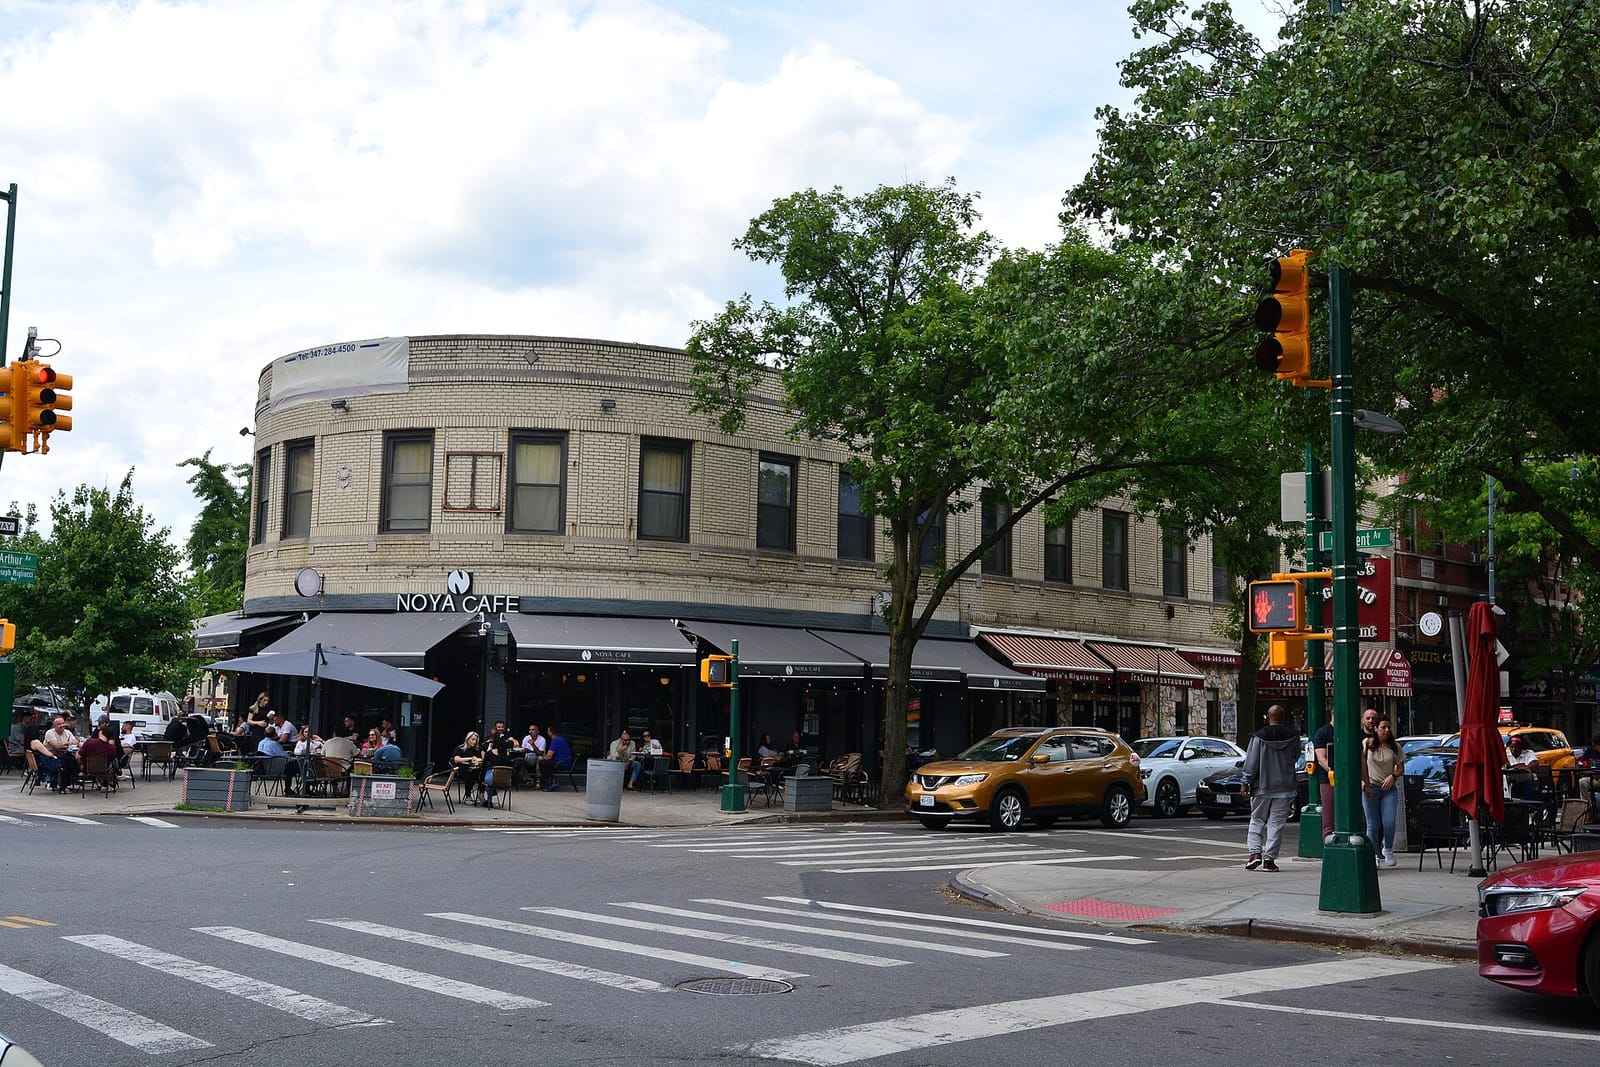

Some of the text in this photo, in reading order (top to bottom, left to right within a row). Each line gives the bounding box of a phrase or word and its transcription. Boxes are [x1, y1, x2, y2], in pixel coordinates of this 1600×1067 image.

[1373, 530, 1381, 539] Av
[396, 594, 519, 613] NOYA CAFE
[1287, 592, 1295, 621] 3
[1032, 670, 1099, 681] Pasquale's Rigoletto
